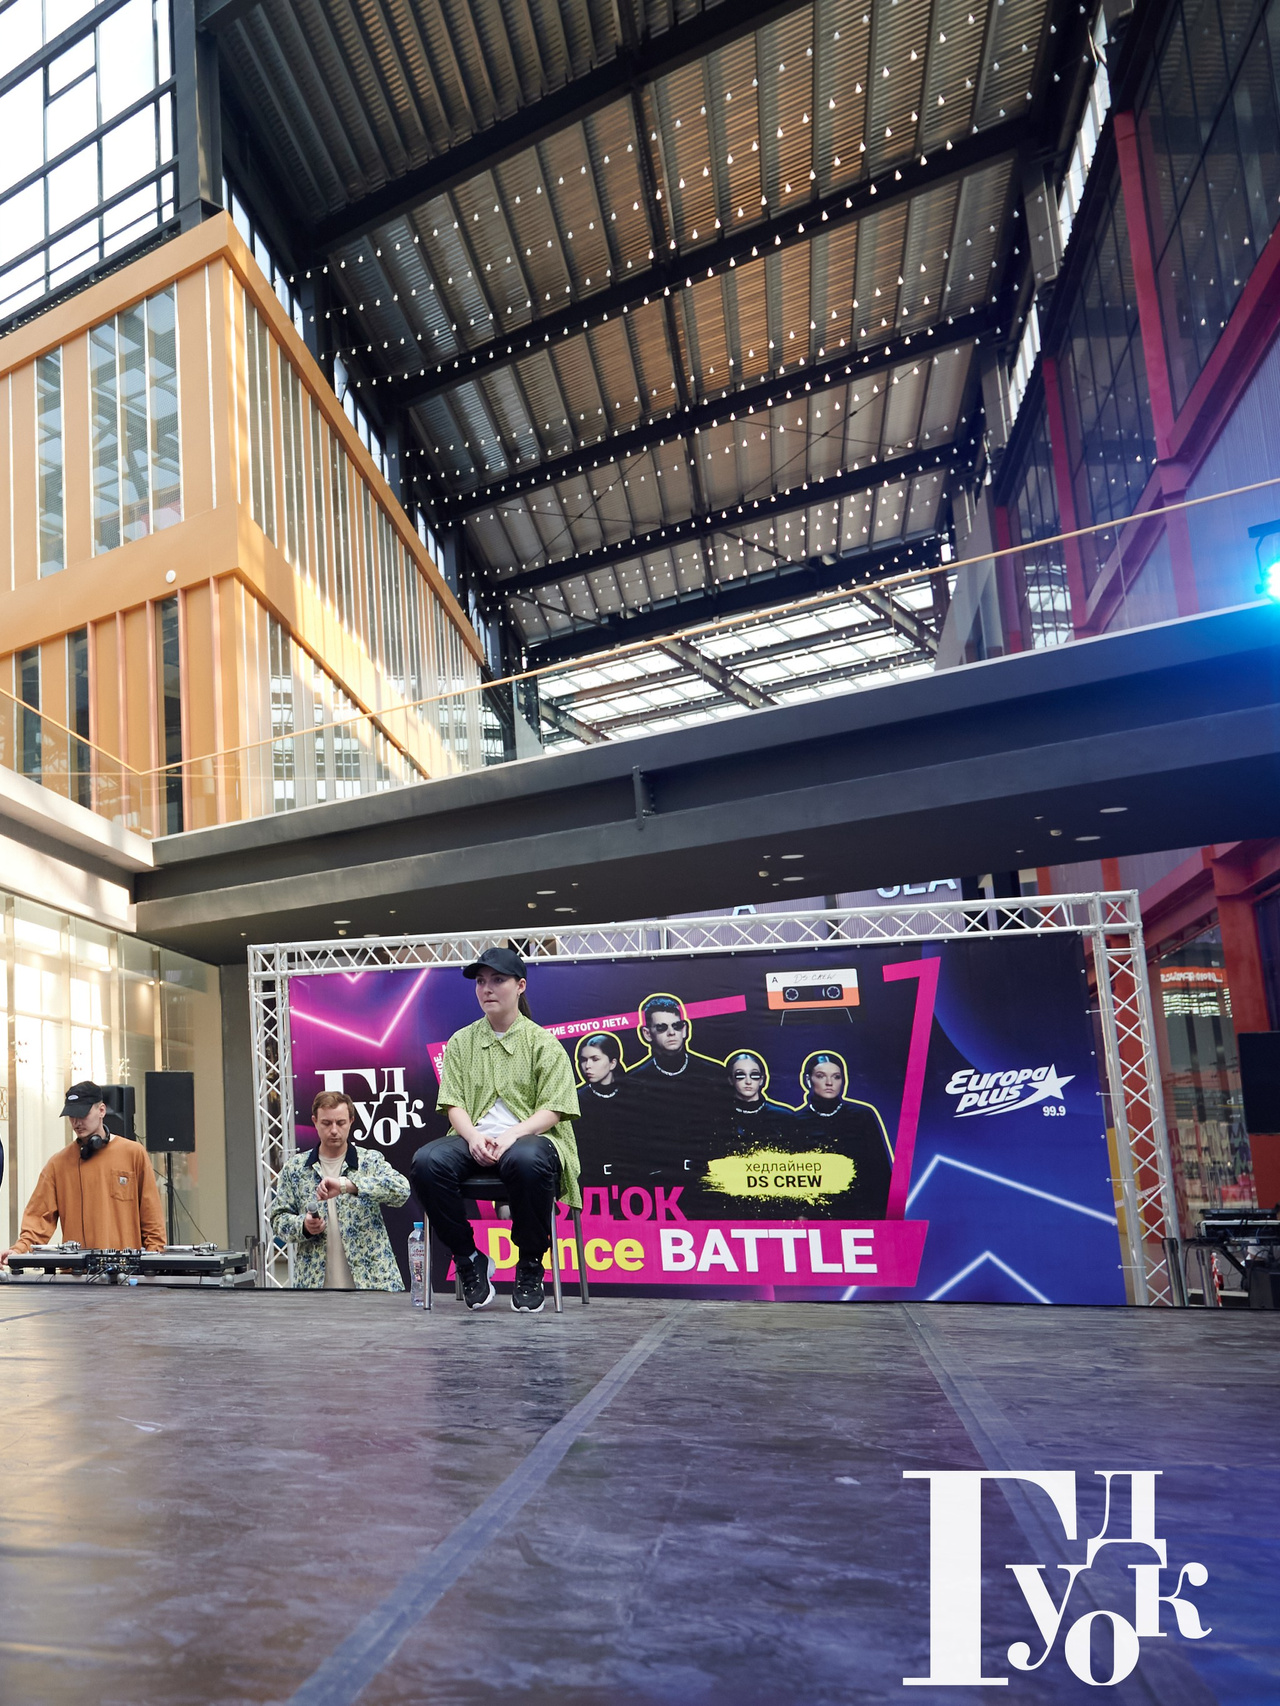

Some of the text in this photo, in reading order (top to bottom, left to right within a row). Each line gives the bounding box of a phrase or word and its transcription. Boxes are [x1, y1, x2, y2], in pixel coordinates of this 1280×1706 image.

[567, 1021, 602, 1034] ЭТОГО
[602, 1016, 629, 1028] ЛЕТА
[945, 1066, 1049, 1095] Europa
[1042, 1105, 1066, 1117] 99.9
[745, 1160, 822, 1174] хедлайнер
[747, 1175, 822, 1188] DS CREW
[487, 1227, 878, 1273] Dnce BATTLE
